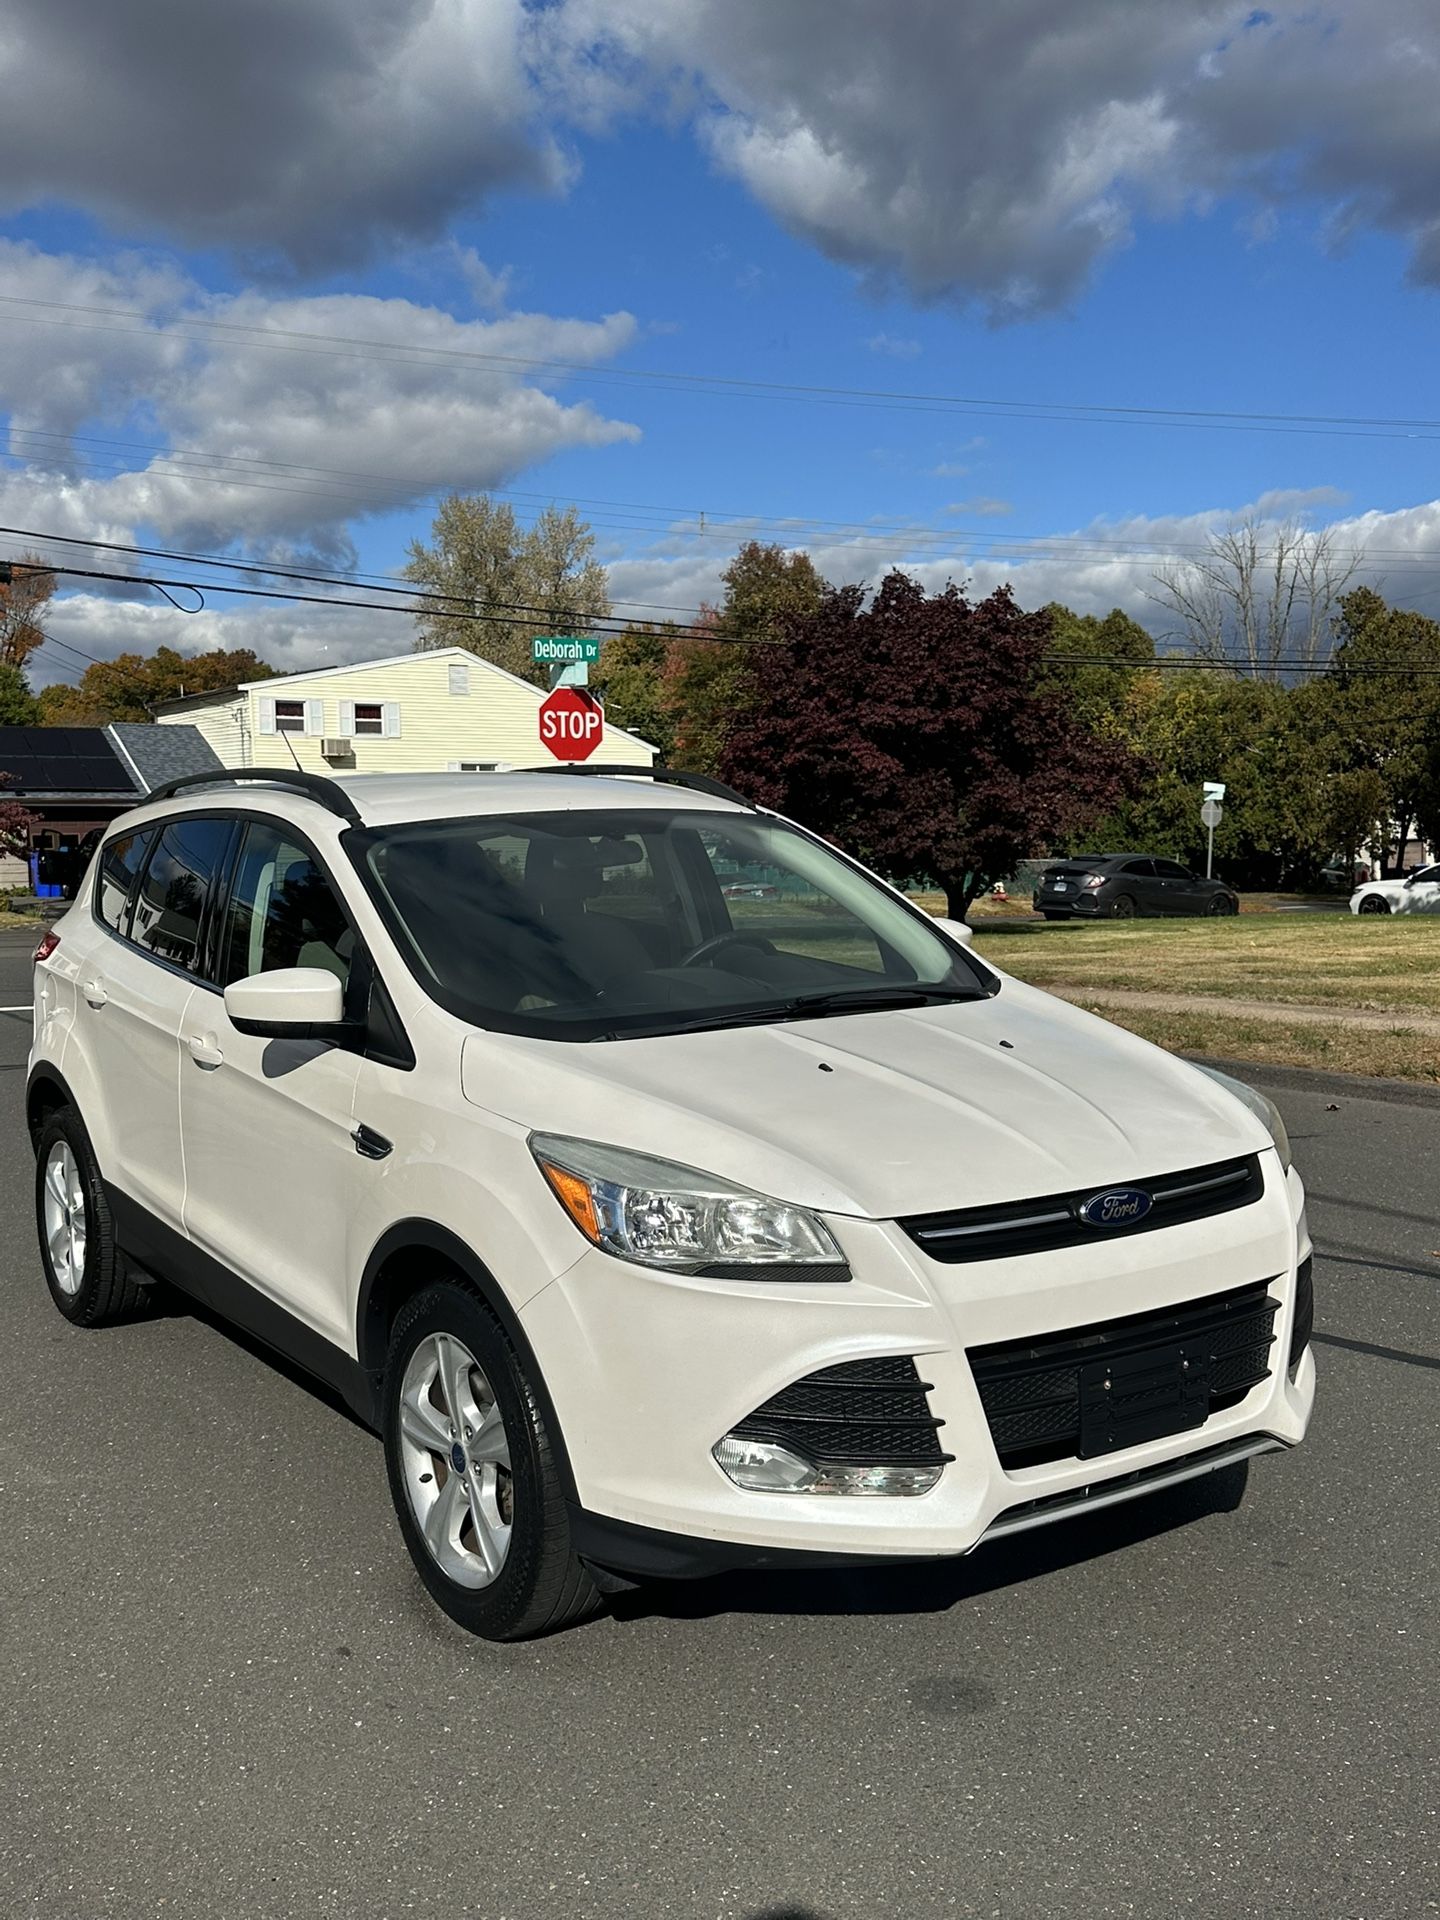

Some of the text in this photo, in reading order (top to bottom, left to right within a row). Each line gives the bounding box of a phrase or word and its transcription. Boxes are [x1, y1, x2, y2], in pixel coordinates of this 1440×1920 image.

[534, 639, 597, 659] Deborah Dr
[542, 710, 600, 739] STOP
[1101, 1193, 1140, 1220] Ford
